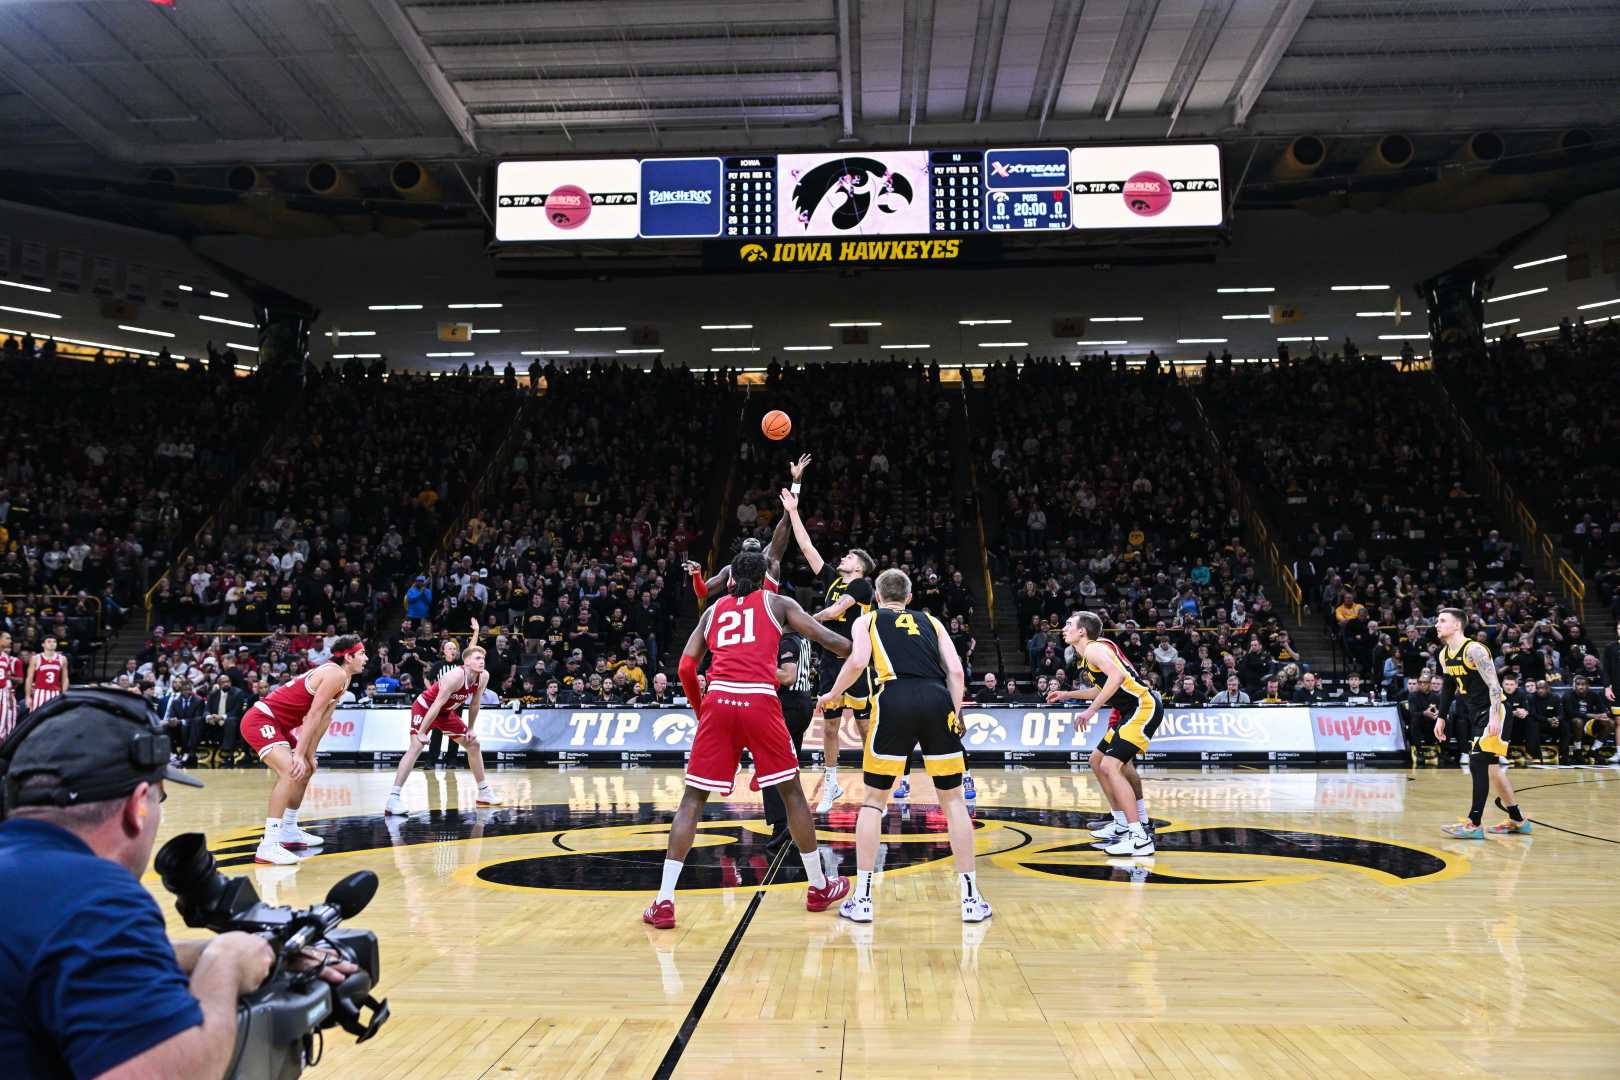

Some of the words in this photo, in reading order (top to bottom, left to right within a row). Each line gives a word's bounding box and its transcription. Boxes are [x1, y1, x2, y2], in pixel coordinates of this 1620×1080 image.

[937, 178, 942, 186] 1
[1090, 183, 1106, 192] TIP
[1186, 181, 1204, 190] OFF
[730, 183, 736, 191] 2
[935, 189, 944, 197] 10
[514, 197, 529, 205] TIP
[606, 195, 623, 204] OFF
[649, 190, 712, 206] PANCHEROS
[730, 194, 736, 202] 3
[935, 200, 944, 208] 11
[730, 205, 736, 213] 4
[997, 202, 1005, 216] 0
[1014, 202, 1047, 216] 20:00
[1054, 202, 1063, 215] 0
[935, 211, 944, 219] 21
[936, 222, 945, 230] 32
[1024, 218, 1037, 227] 1ST
[728, 227, 738, 235] 32
[772, 242, 832, 262] IOWA
[838, 239, 960, 261] HAWKEYES
[717, 608, 756, 648] 21
[895, 613, 920, 635] 4
[46, 672, 55, 683] 3
[570, 712, 640, 745] TIP
[1021, 712, 1099, 745] OFF
